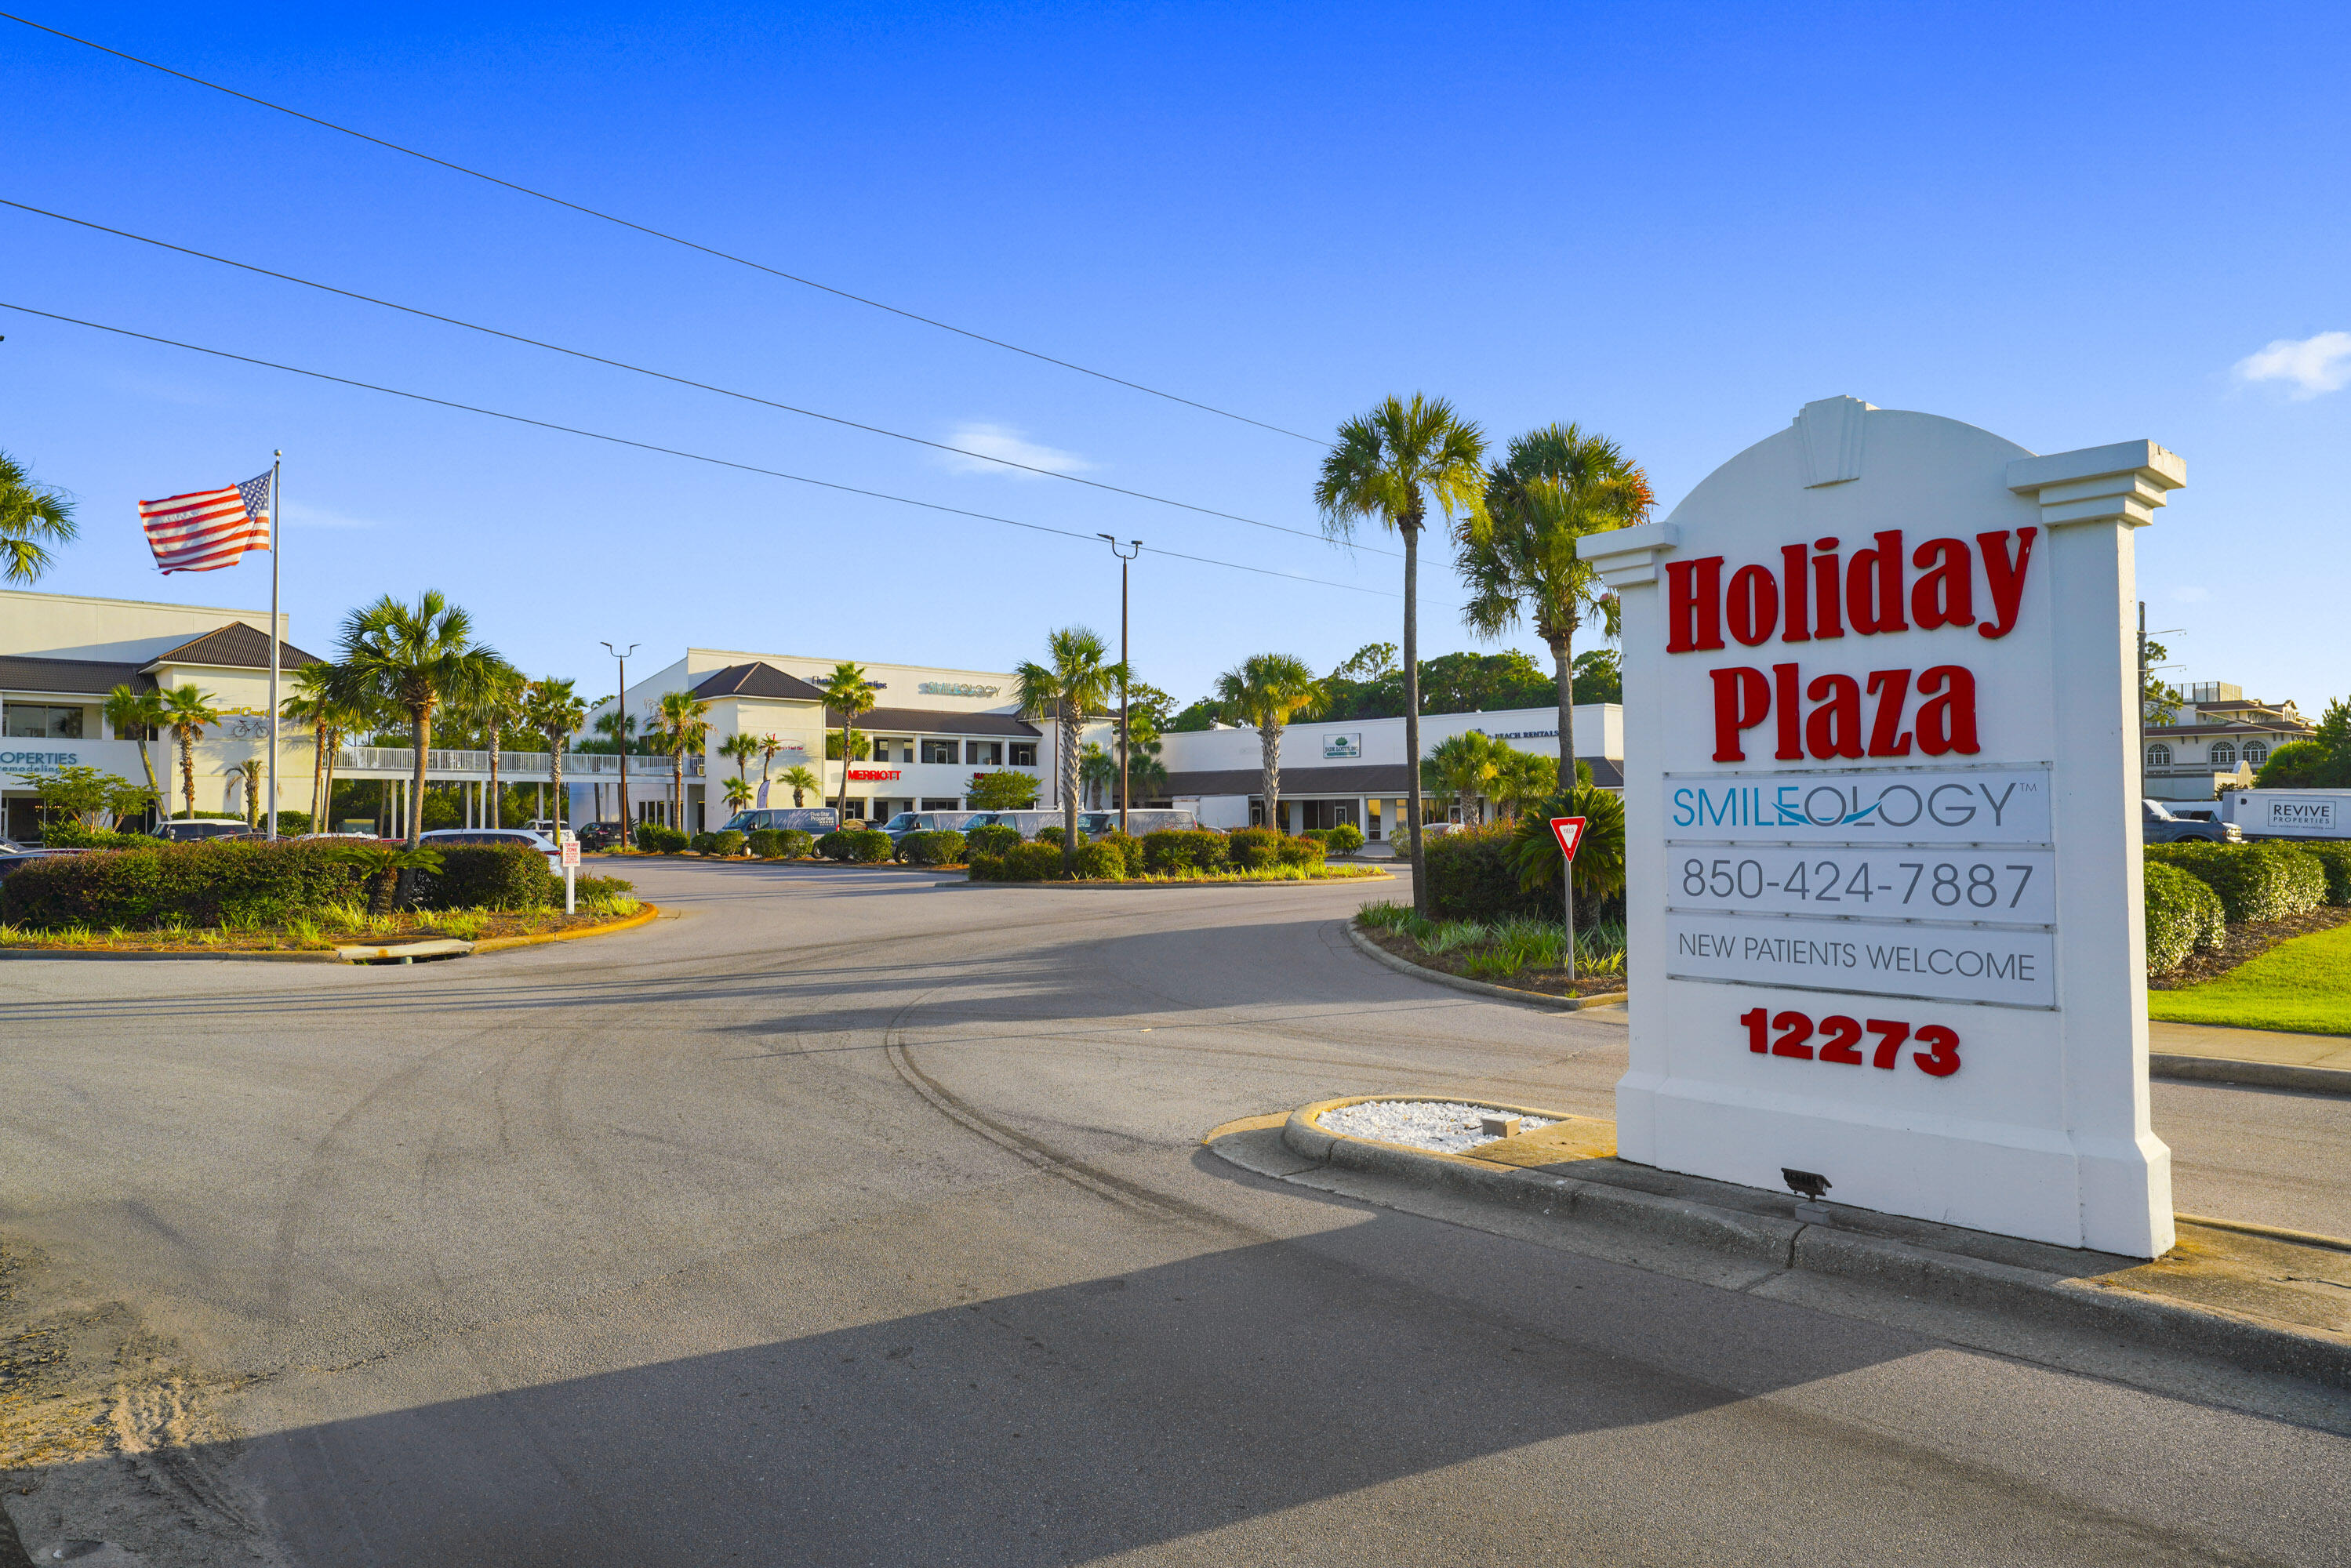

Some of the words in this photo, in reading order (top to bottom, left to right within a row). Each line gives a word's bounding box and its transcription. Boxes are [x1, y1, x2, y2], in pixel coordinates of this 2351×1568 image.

[1665, 527, 2038, 654] Holiday
[1523, 730, 1559, 739] RENTALS
[1709, 662, 1981, 762] Plaza
[0, 751, 78, 764] OPERTIES
[848, 770, 901, 781] MERRIOTT
[1672, 782, 2016, 827] SMILEOLOGY
[2020, 782, 2037, 791] TM
[2273, 804, 2330, 817] REVIVE
[1682, 858, 2033, 908] 850-424-7887
[1679, 933, 1736, 959] NEW
[1744, 937, 1857, 967] PATIENTS
[1866, 945, 2035, 981] WELCOME
[1739, 1007, 1960, 1076] 12273
